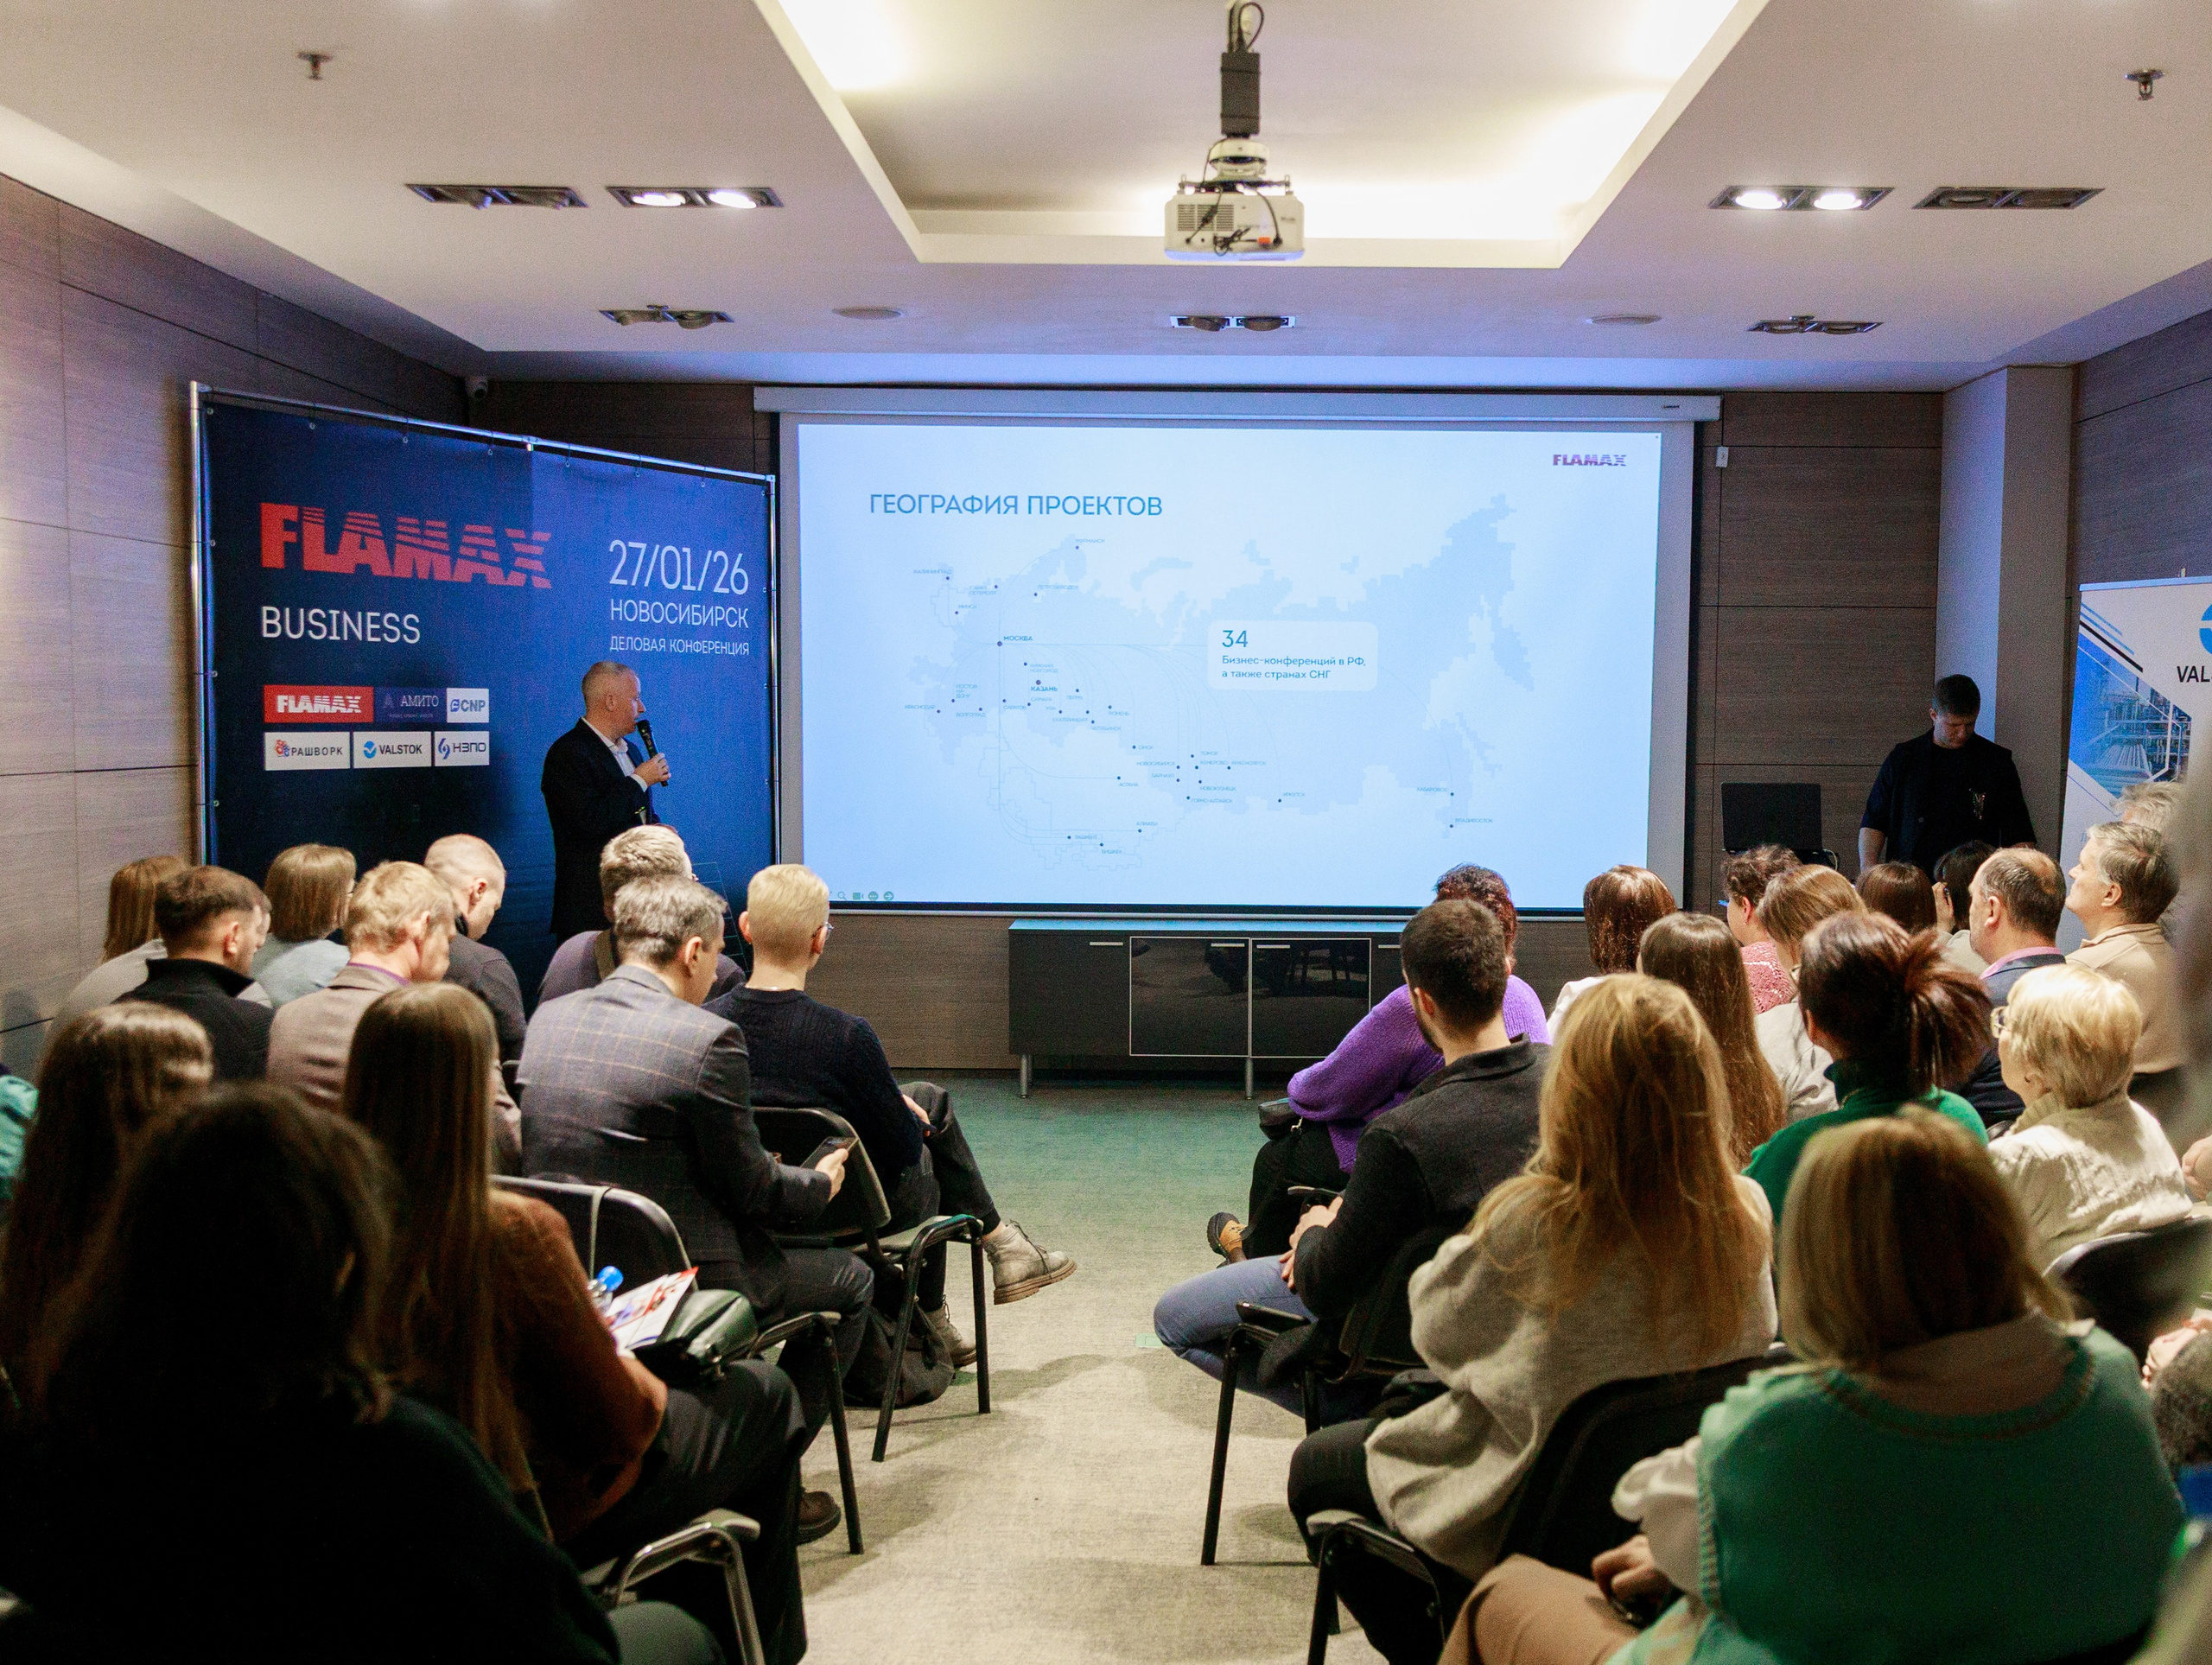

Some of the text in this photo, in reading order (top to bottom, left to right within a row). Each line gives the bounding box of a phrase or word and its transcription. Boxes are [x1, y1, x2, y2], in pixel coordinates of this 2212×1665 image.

[1553, 454, 1626, 467] FLAMAX
[870, 493, 1162, 516] ГЕОГРАФИЯ ПРОЕКТОВ
[261, 503, 551, 588] FLAMAX
[609, 539, 749, 595] 27/01/26
[611, 599, 748, 628] НОВОСИБИРСК
[262, 606, 420, 644] BUSINESS
[610, 636, 749, 656] ДЕЛОВАЯ КОНФЕРЕНЦИЯ
[1222, 630, 1249, 648] 34
[1222, 655, 1337, 667] Бизнес-конференций
[1264, 671, 1306, 681] странах
[1309, 670, 1331, 679] СНГ
[2177, 665, 2212, 683] VAL
[276, 695, 362, 714] FLAMAX
[400, 695, 440, 707] АМИТО
[461, 699, 486, 712] CNP
[291, 747, 343, 756] РАШВОРК
[379, 745, 423, 754] VALSTOK
